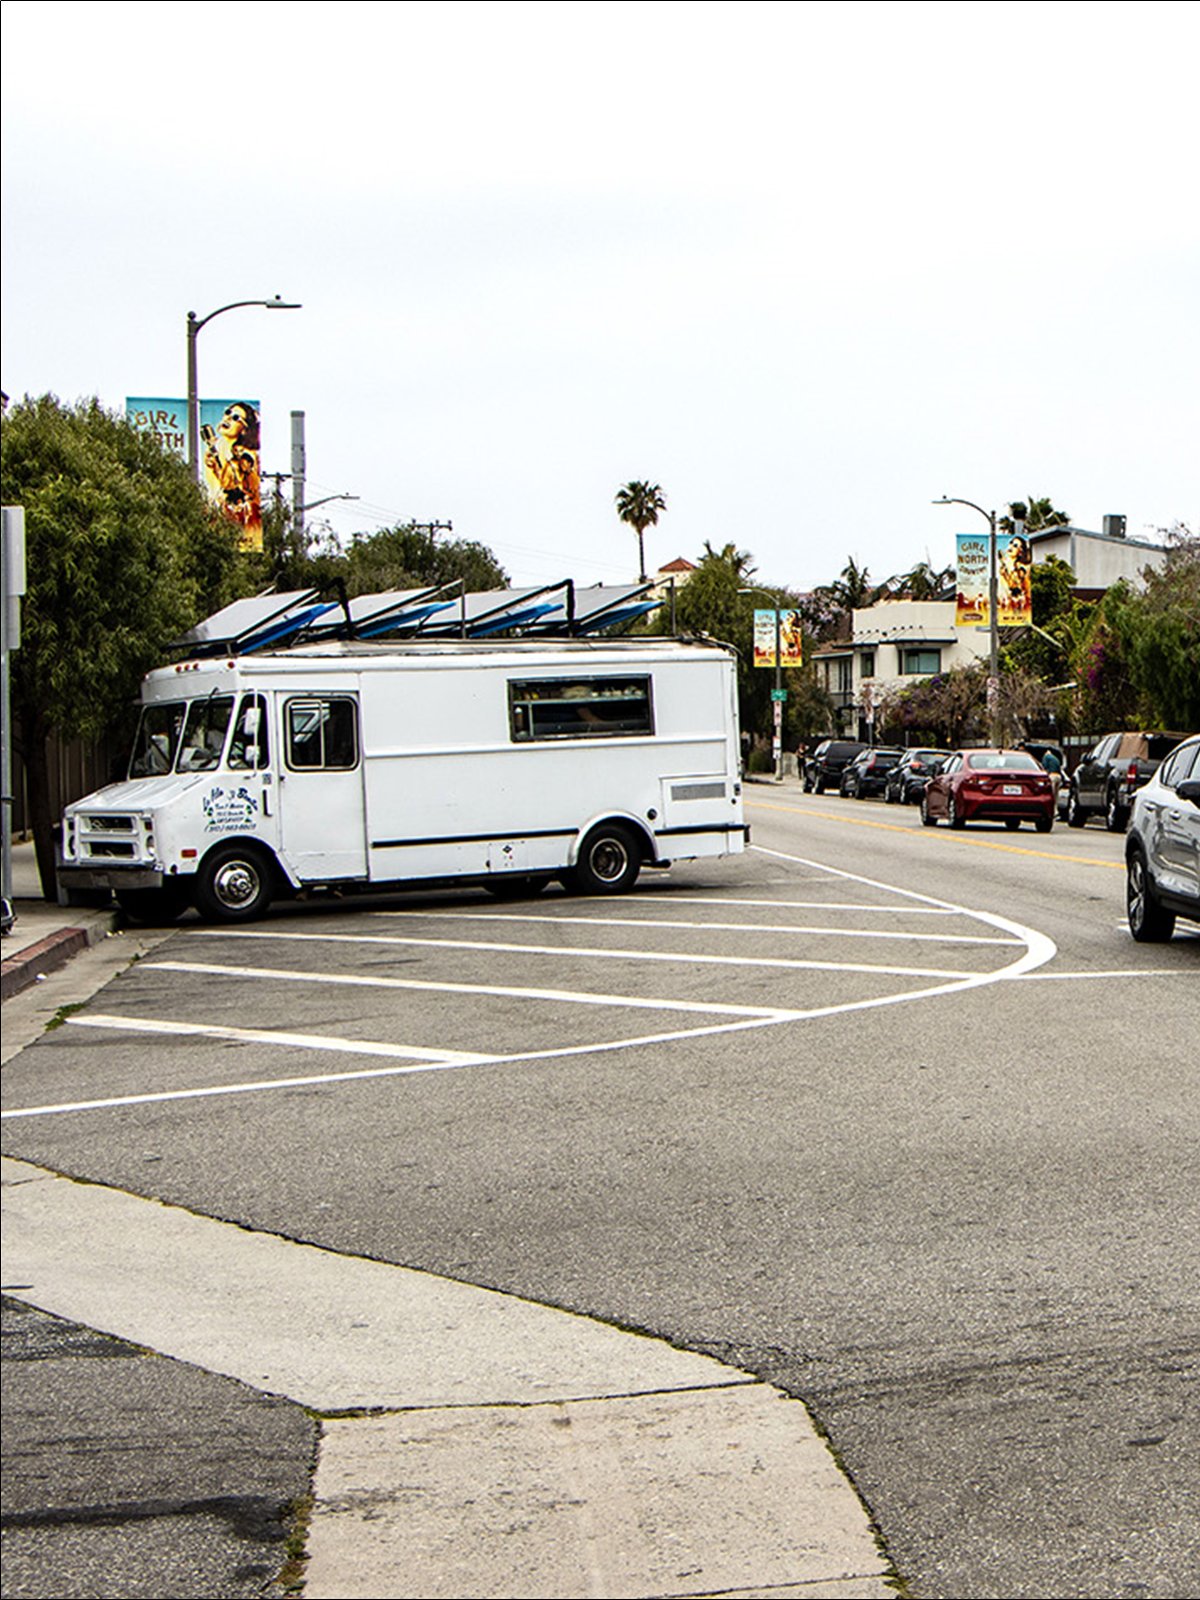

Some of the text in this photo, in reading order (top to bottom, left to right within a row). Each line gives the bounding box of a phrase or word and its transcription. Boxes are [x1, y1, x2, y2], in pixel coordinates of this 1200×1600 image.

[135, 411, 178, 428] GIRL
[961, 542, 984, 553] GIRL
[958, 555, 988, 563] NORTH
